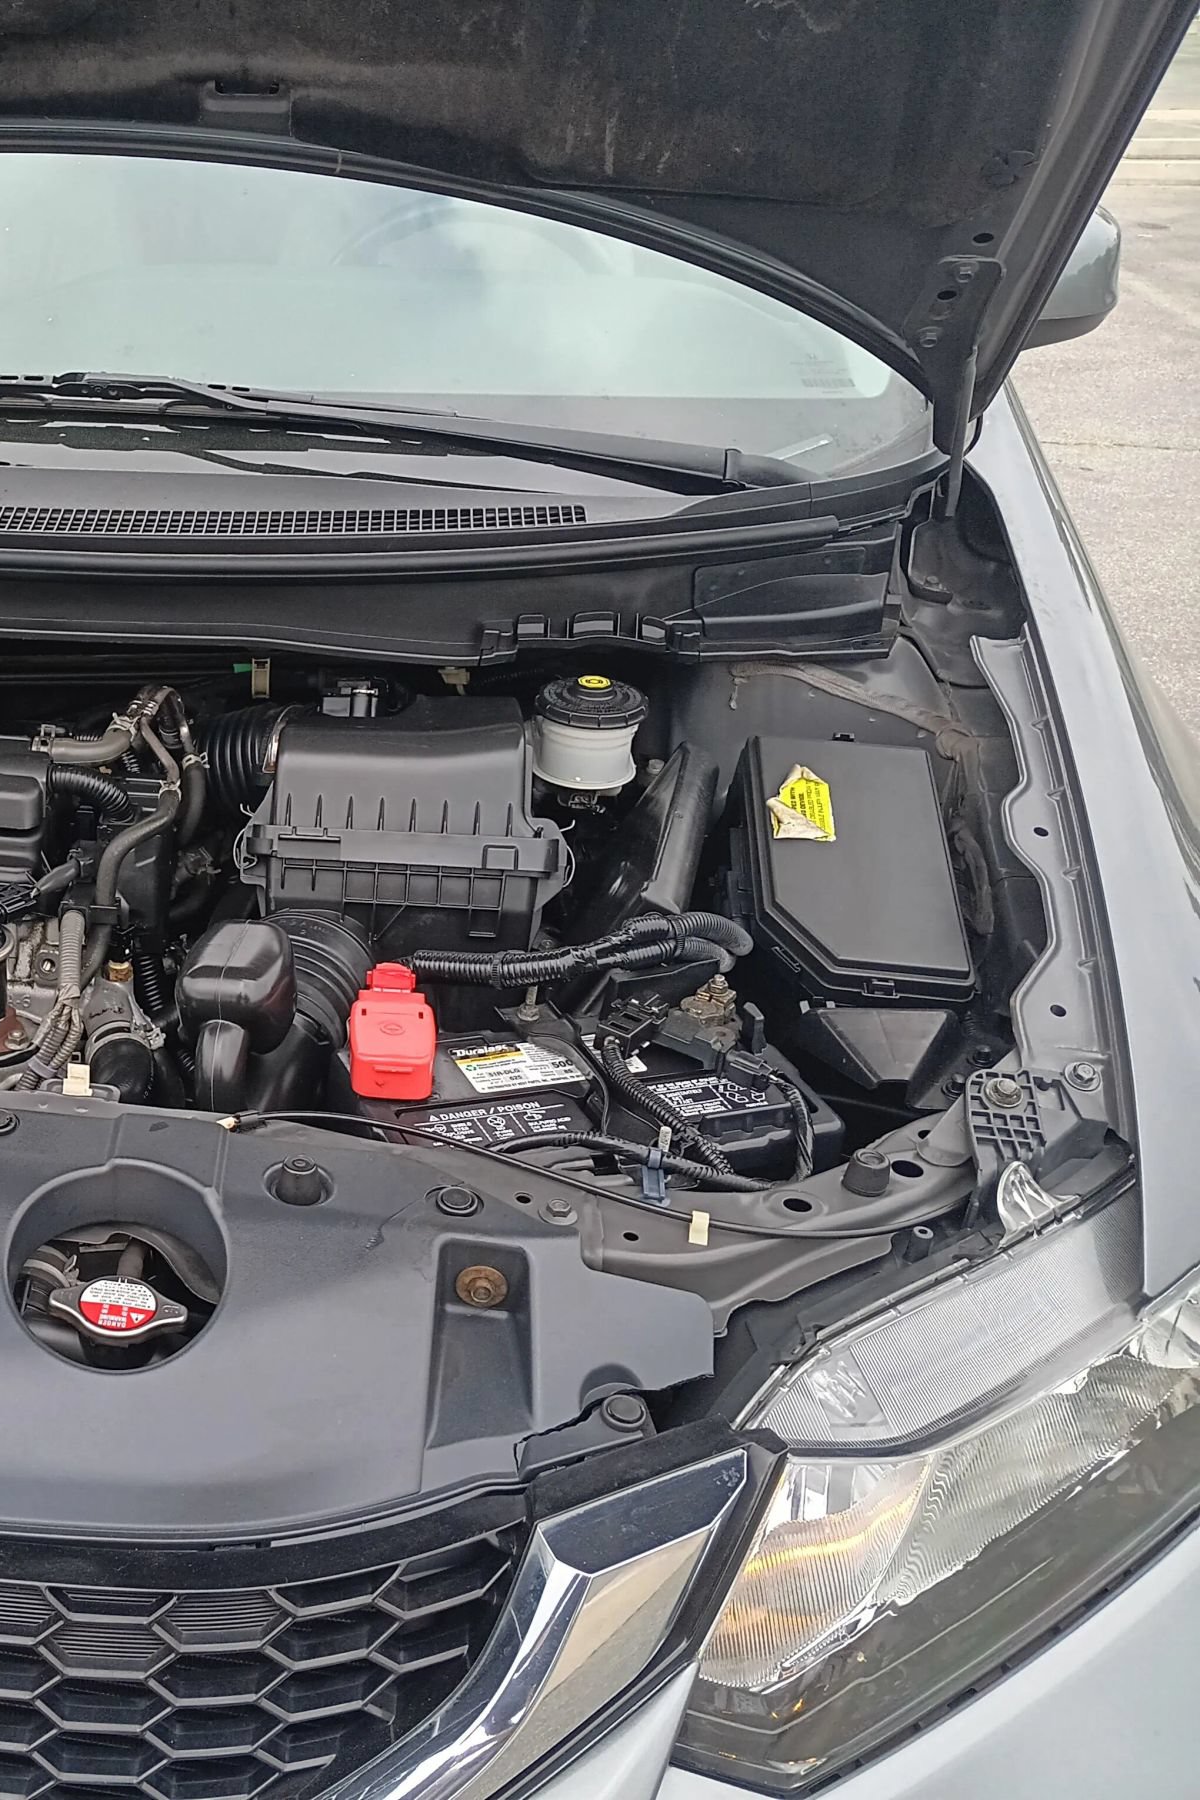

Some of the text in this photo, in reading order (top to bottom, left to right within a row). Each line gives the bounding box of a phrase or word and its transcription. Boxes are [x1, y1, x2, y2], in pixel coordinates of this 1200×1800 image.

[452, 1043, 509, 1058] Duralast
[439, 1107, 488, 1121] DANGER
[498, 1101, 541, 1113] POISON
